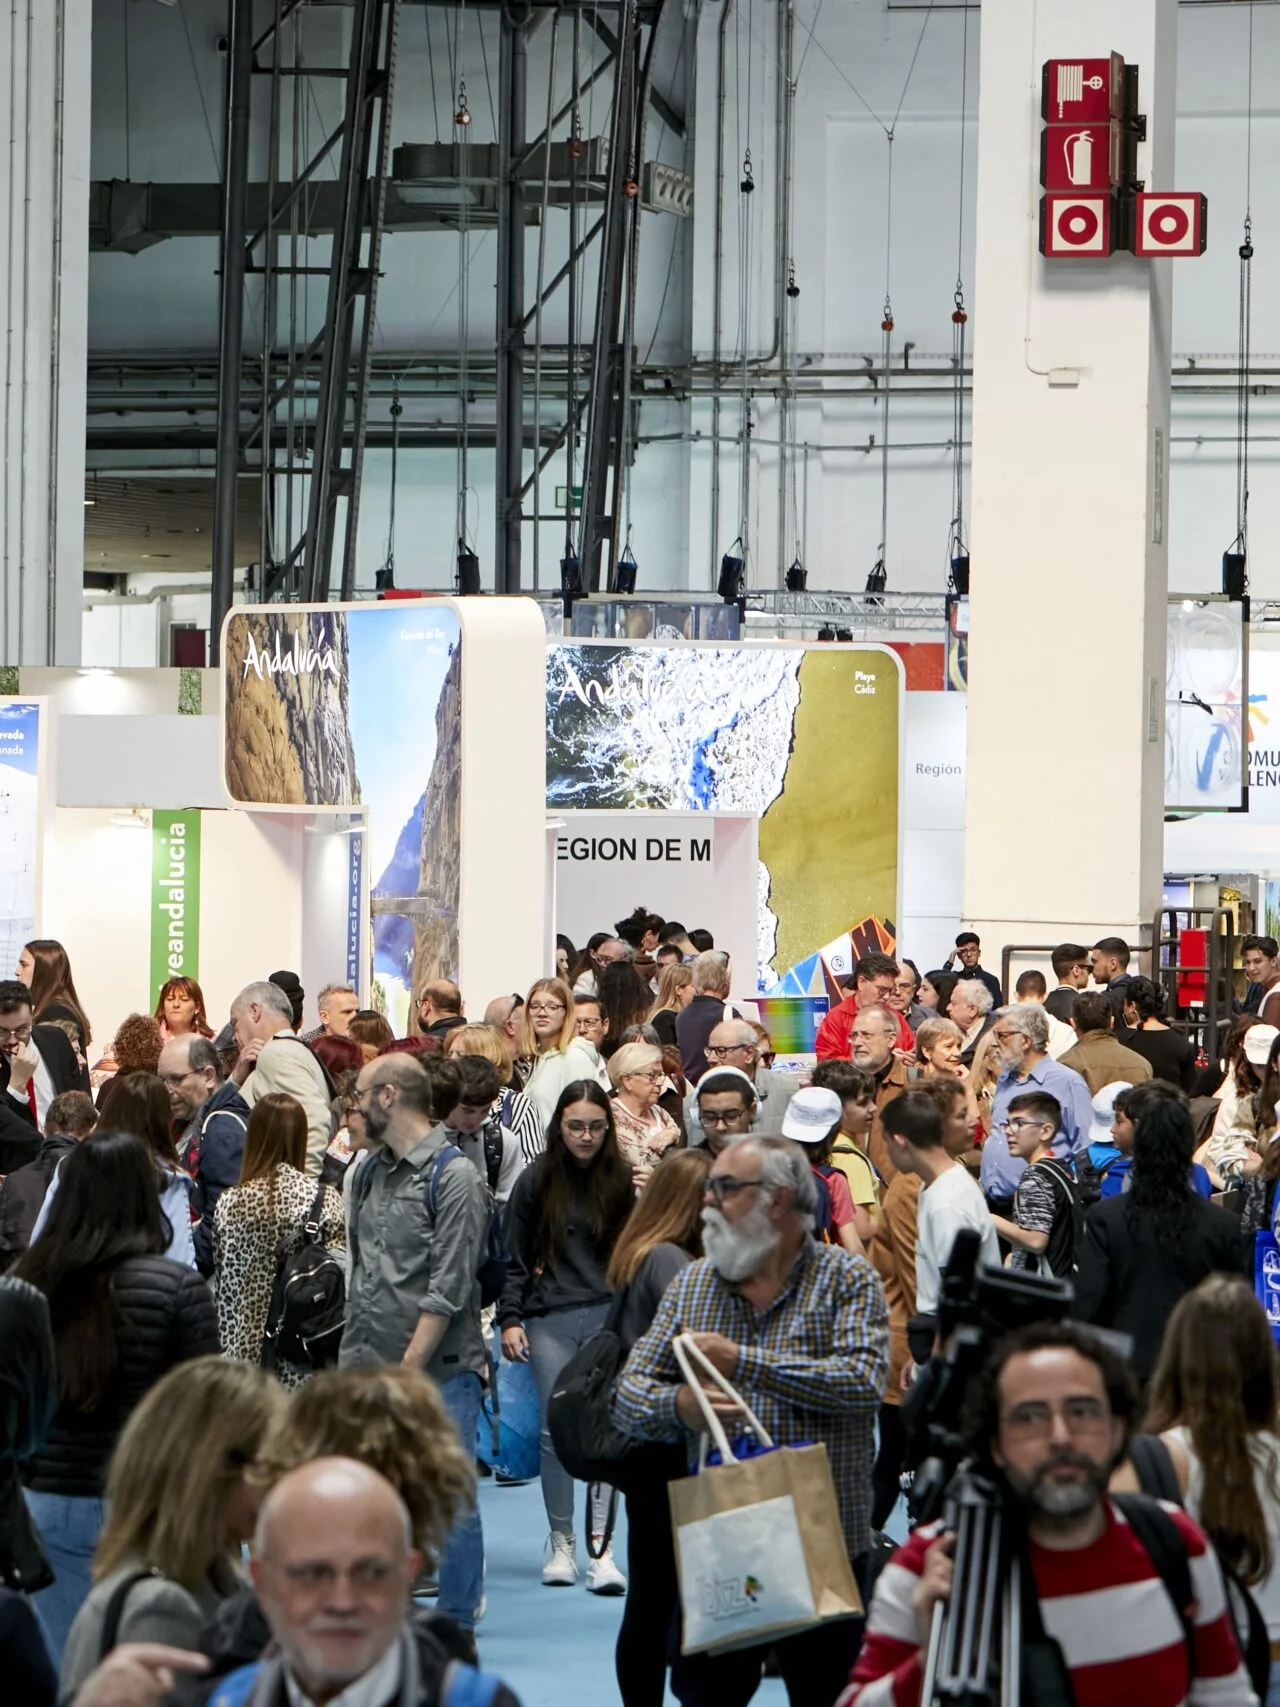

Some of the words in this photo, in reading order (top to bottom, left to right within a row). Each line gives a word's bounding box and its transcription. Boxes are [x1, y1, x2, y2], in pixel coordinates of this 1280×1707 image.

[242, 627, 341, 681] Andalucía
[855, 671, 876, 683] Playa
[854, 683, 876, 694] Cádiz
[916, 763, 961, 778] Región
[646, 838, 681, 861] DE
[690, 839, 711, 861] M
